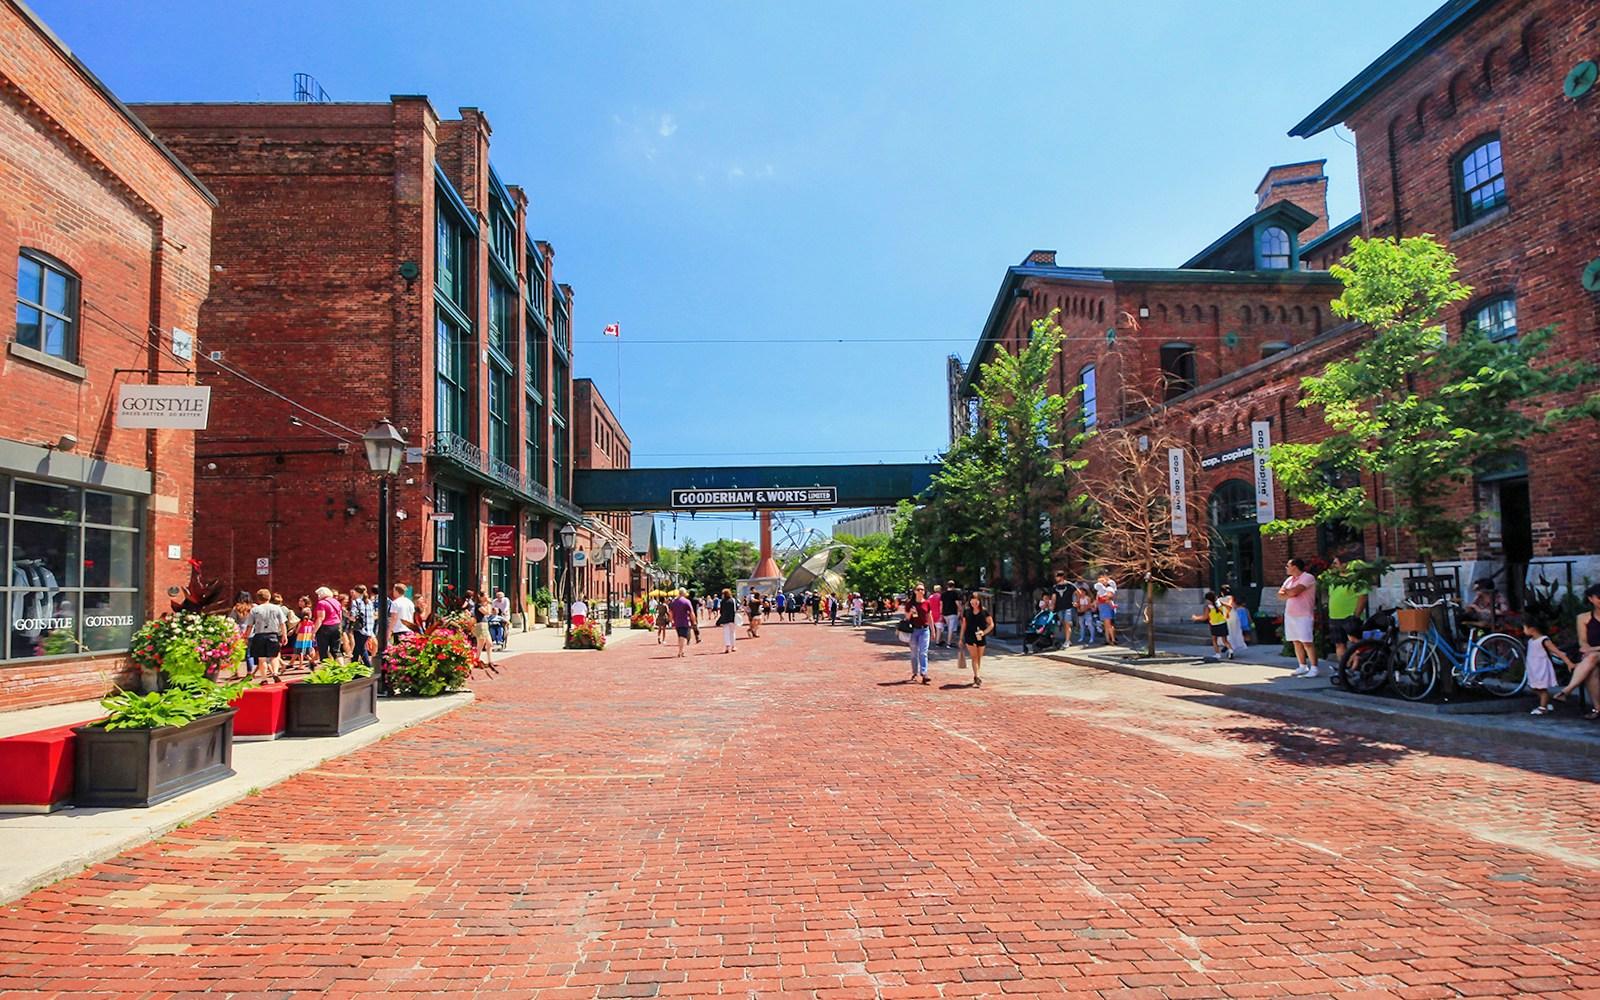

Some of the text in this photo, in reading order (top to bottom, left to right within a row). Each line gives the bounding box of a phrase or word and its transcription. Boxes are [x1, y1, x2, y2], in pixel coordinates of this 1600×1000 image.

[122, 398, 203, 411] GOTSTYLE
[1201, 448, 1253, 468] cop. copine
[679, 491, 753, 504] GOODERHAM
[756, 491, 765, 502] &
[766, 490, 807, 502] WORTS
[14, 617, 73, 631] GOTSTYLE
[85, 615, 134, 627] GOTSTYLE
